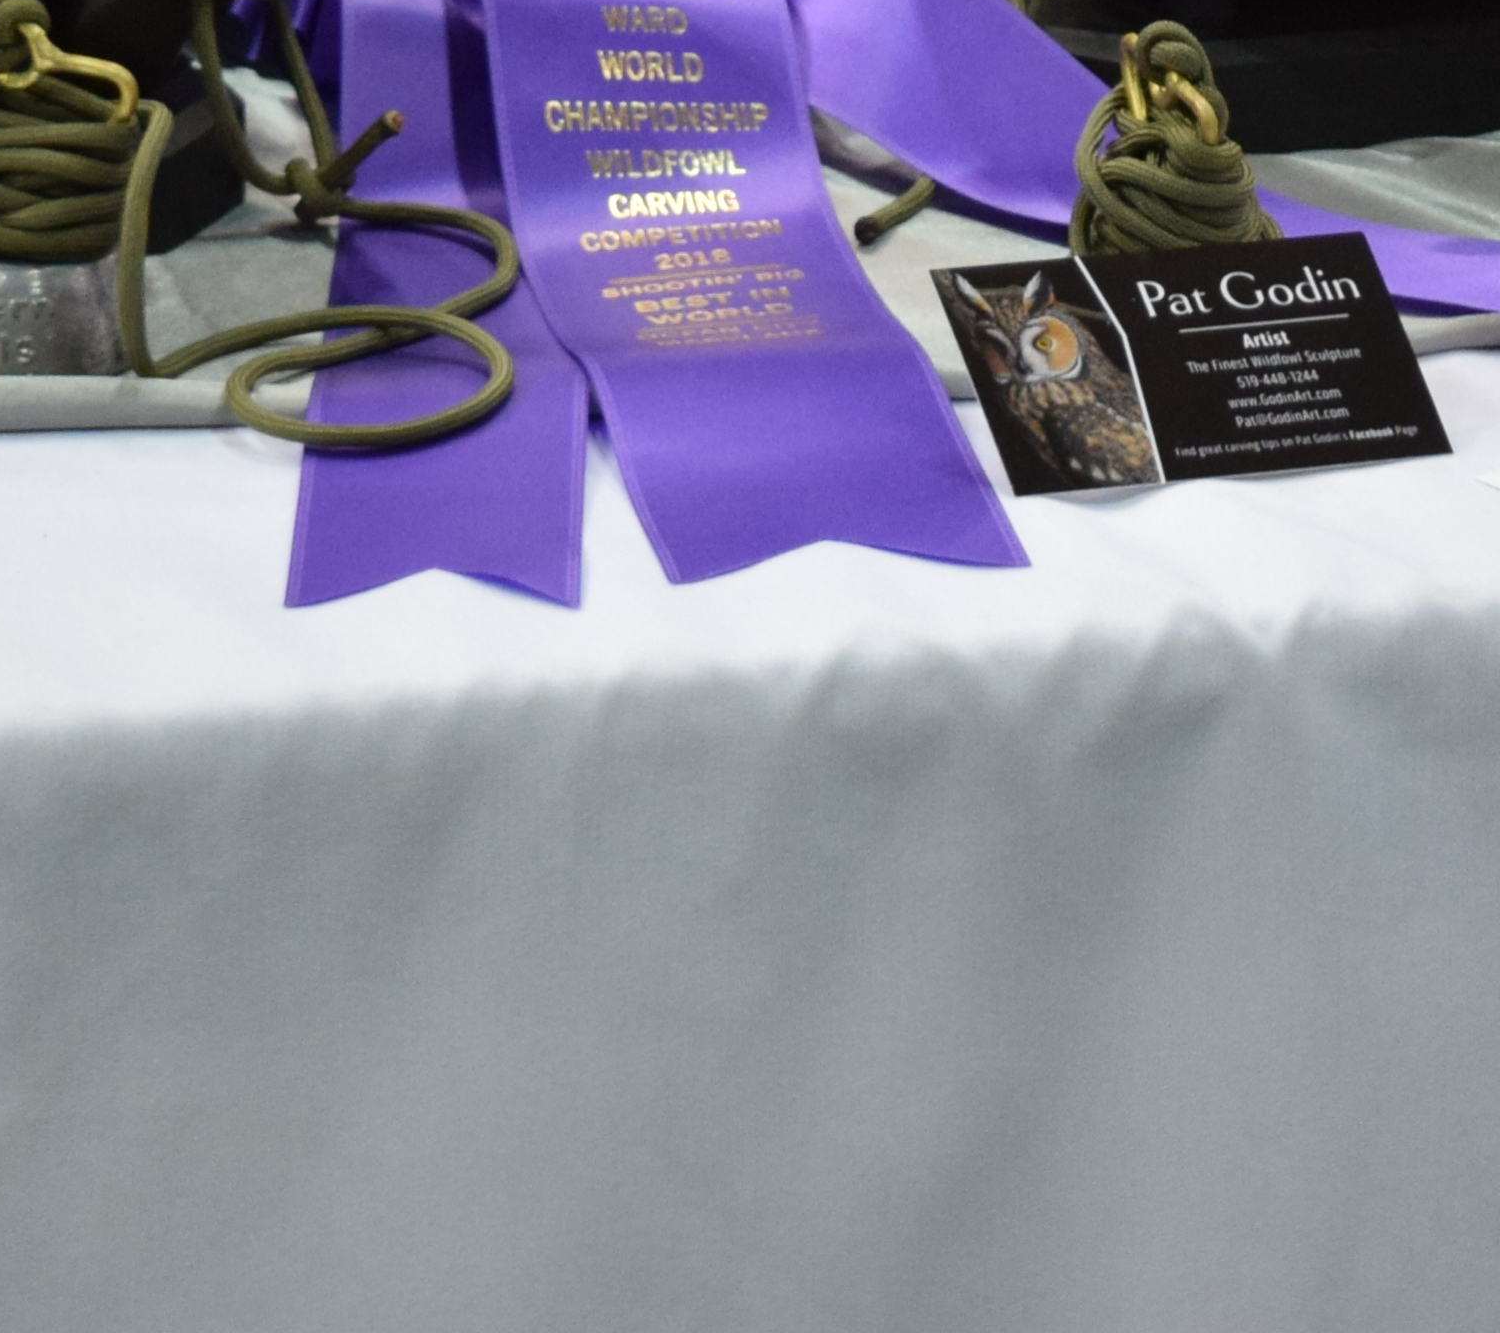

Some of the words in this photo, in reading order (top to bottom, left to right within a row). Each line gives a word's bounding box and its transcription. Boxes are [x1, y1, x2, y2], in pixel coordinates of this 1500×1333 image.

[602, 5, 688, 35] WARD
[597, 49, 704, 83] WORLD
[544, 100, 769, 133] CHAMPIONSHIP
[585, 148, 747, 178] WILDFOWL
[607, 189, 741, 219] CARVING
[580, 218, 783, 253] COMPETITION
[653, 248, 732, 270] 2018
[1136, 279, 1213, 318] Pat
[1219, 265, 1361, 310] Godin
[1242, 330, 1291, 349] Artist
[1186, 360, 1210, 374] The
[1212, 355, 1249, 371] Finest
[1250, 351, 1302, 368] Wildfowl
[1306, 346, 1362, 365] Sculpture
[1236, 369, 1320, 389] 519-448-1244
[1227, 387, 1342, 410] www.GodinArt.com
[1235, 406, 1350, 429] Pat@GodinArt.com
[1199, 443, 1224, 459] great
[1225, 438, 1261, 454] carving
[1262, 436, 1281, 451] tips
[1282, 436, 1295, 447] on
[1295, 433, 1312, 446] Pat
[1349, 425, 1395, 440] Facebook
[1395, 424, 1419, 436] Page
